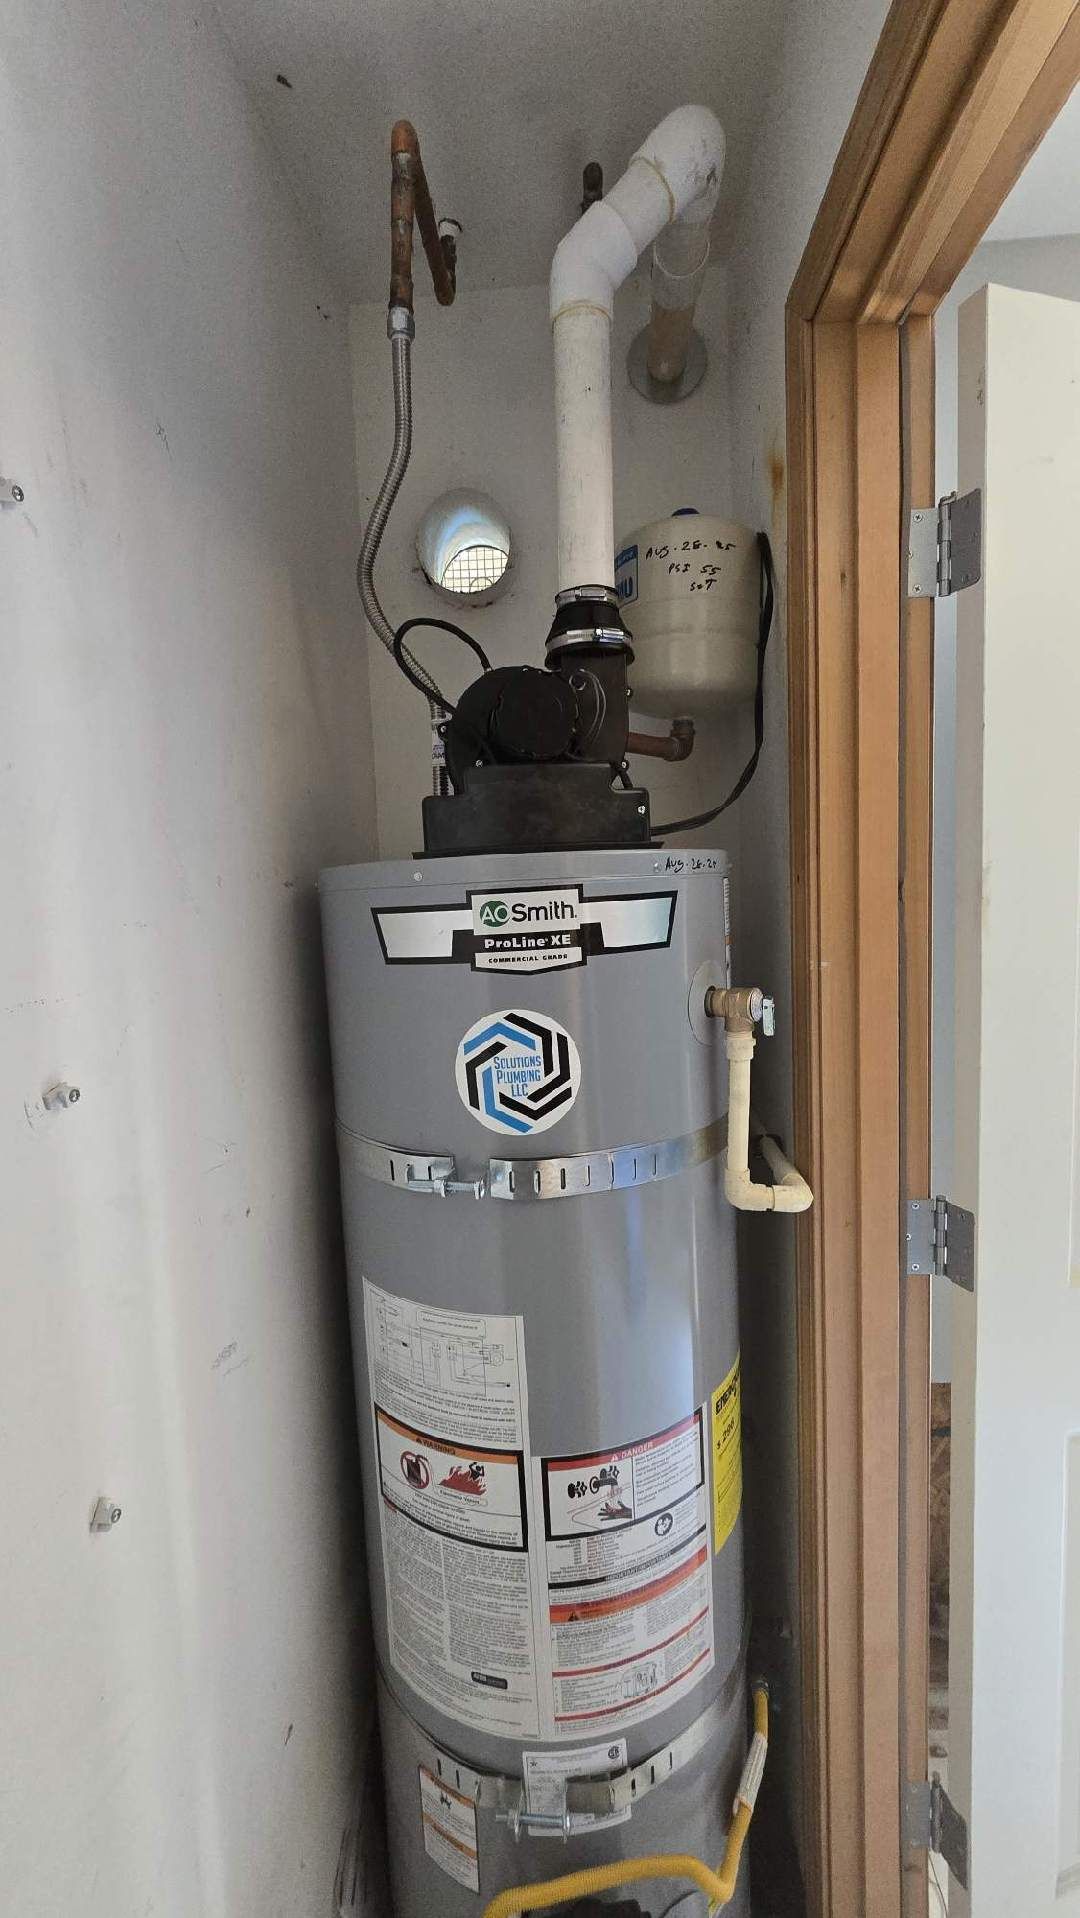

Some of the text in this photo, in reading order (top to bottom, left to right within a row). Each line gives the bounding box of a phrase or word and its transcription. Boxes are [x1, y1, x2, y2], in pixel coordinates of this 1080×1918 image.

[669, 563, 721, 575] PSI 55
[484, 934, 571, 949] ProLine XE
[488, 953, 568, 964] COMMERCIAL GRADE
[511, 1084, 529, 1097] LLC
[621, 1441, 654, 1459] DANGER
